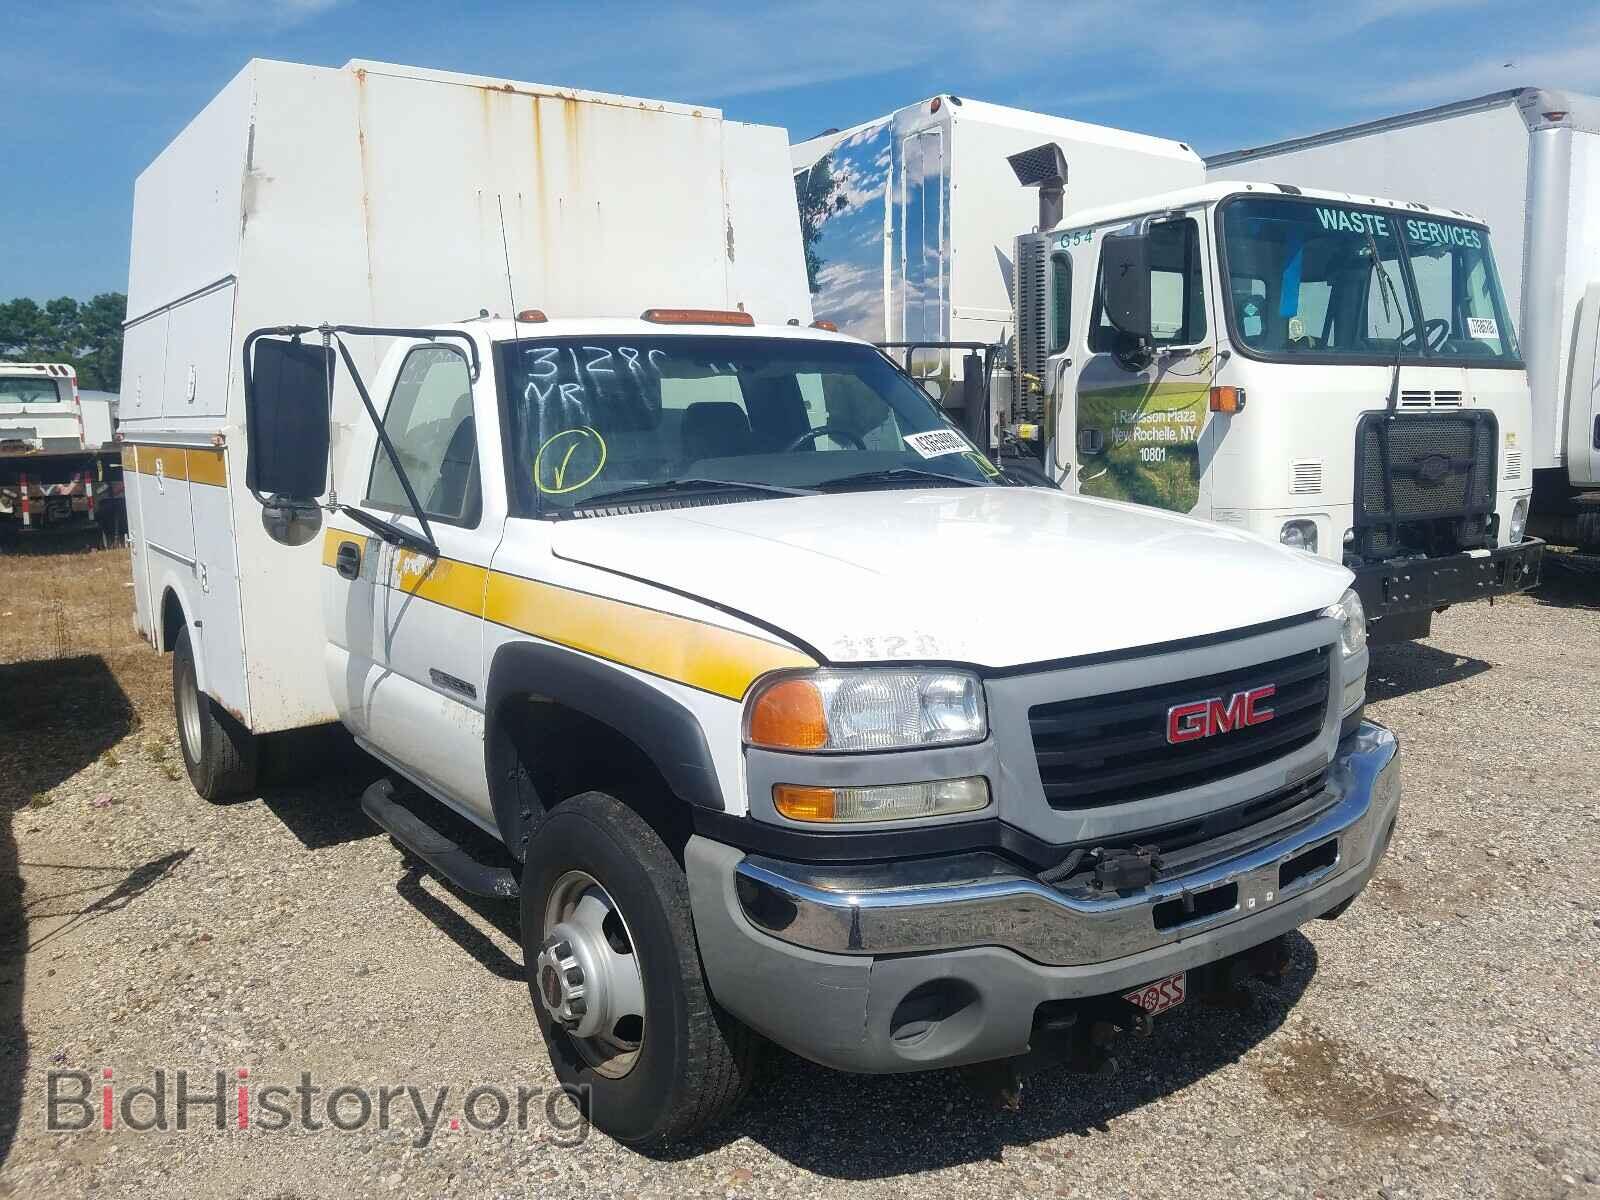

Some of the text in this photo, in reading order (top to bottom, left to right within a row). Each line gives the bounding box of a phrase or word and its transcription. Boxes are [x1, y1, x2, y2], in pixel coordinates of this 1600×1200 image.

[1315, 207, 1482, 249] WASTE SERVICES
[1134, 426, 1178, 443] Rochelle,
[1180, 425, 1197, 441] NY
[1139, 447, 1166, 462] 10801
[1167, 683, 1276, 744] GMC
